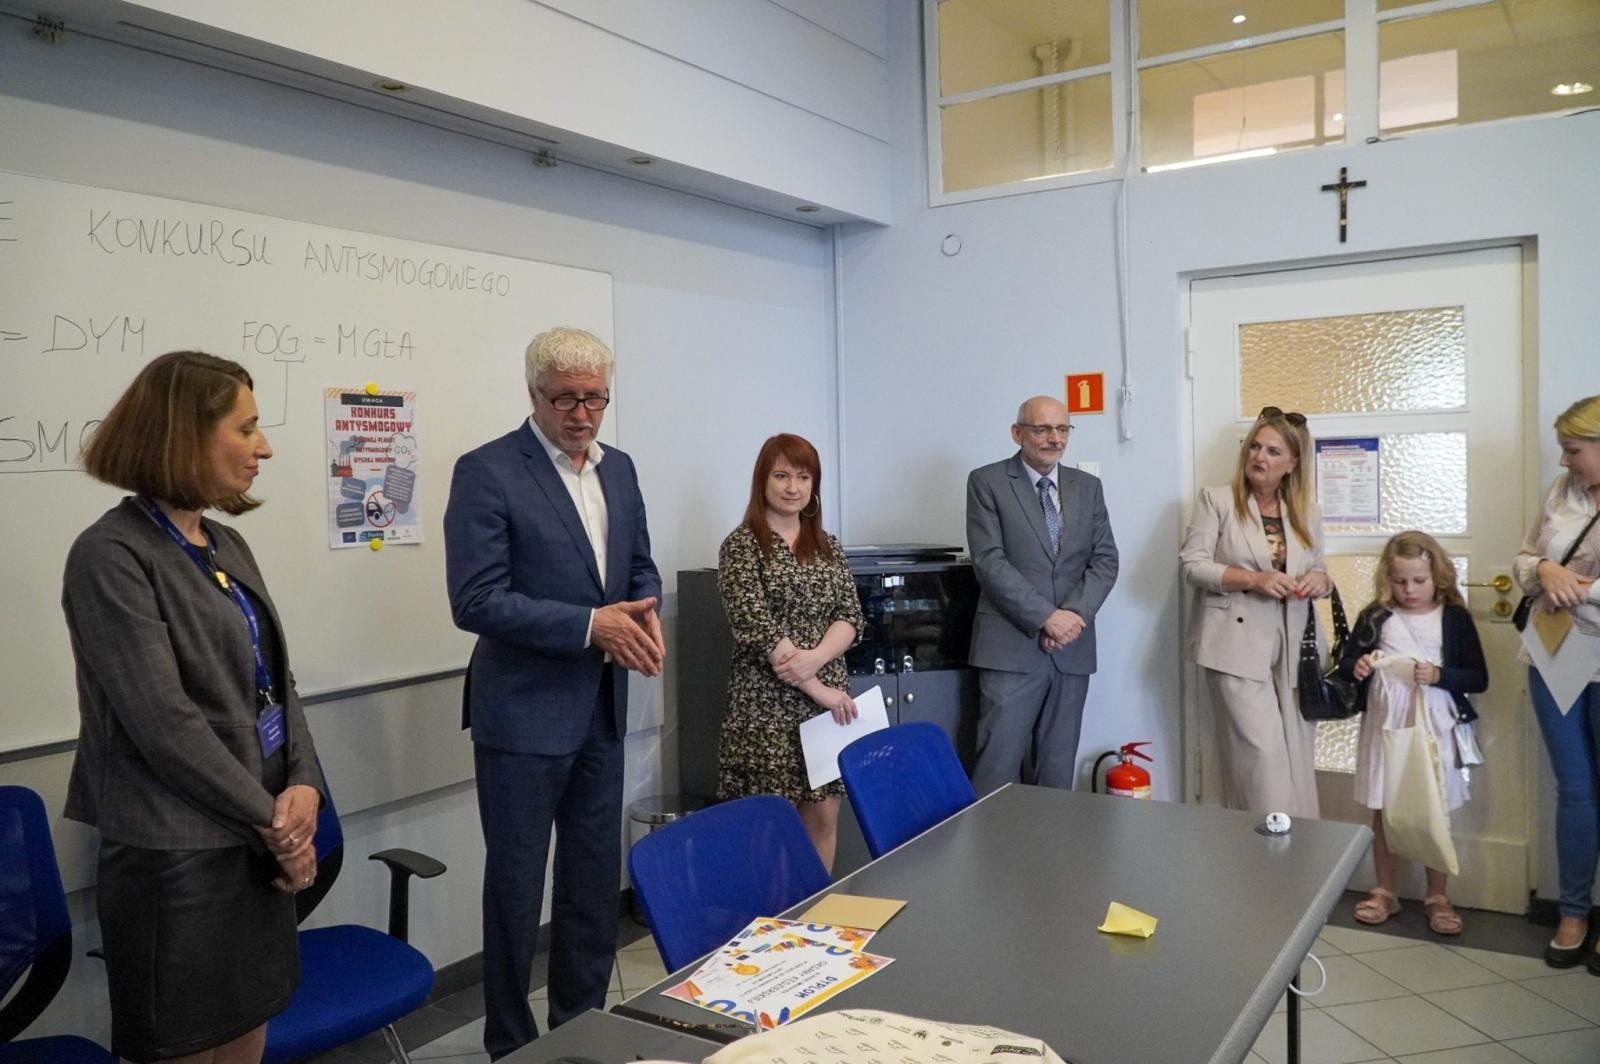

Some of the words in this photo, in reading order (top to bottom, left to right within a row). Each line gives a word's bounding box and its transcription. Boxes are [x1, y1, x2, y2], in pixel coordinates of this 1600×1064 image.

[88, 208, 272, 267] KONKURSU
[304, 241, 511, 297] ANTYSMOGOWEGO
[42, 314, 146, 355] DYM
[241, 321, 300, 355] FOG
[335, 419, 412, 433] ANTYSMOGOWY
[350, 406, 396, 419] KONKURS
[794, 976, 838, 999] DYPLOM
